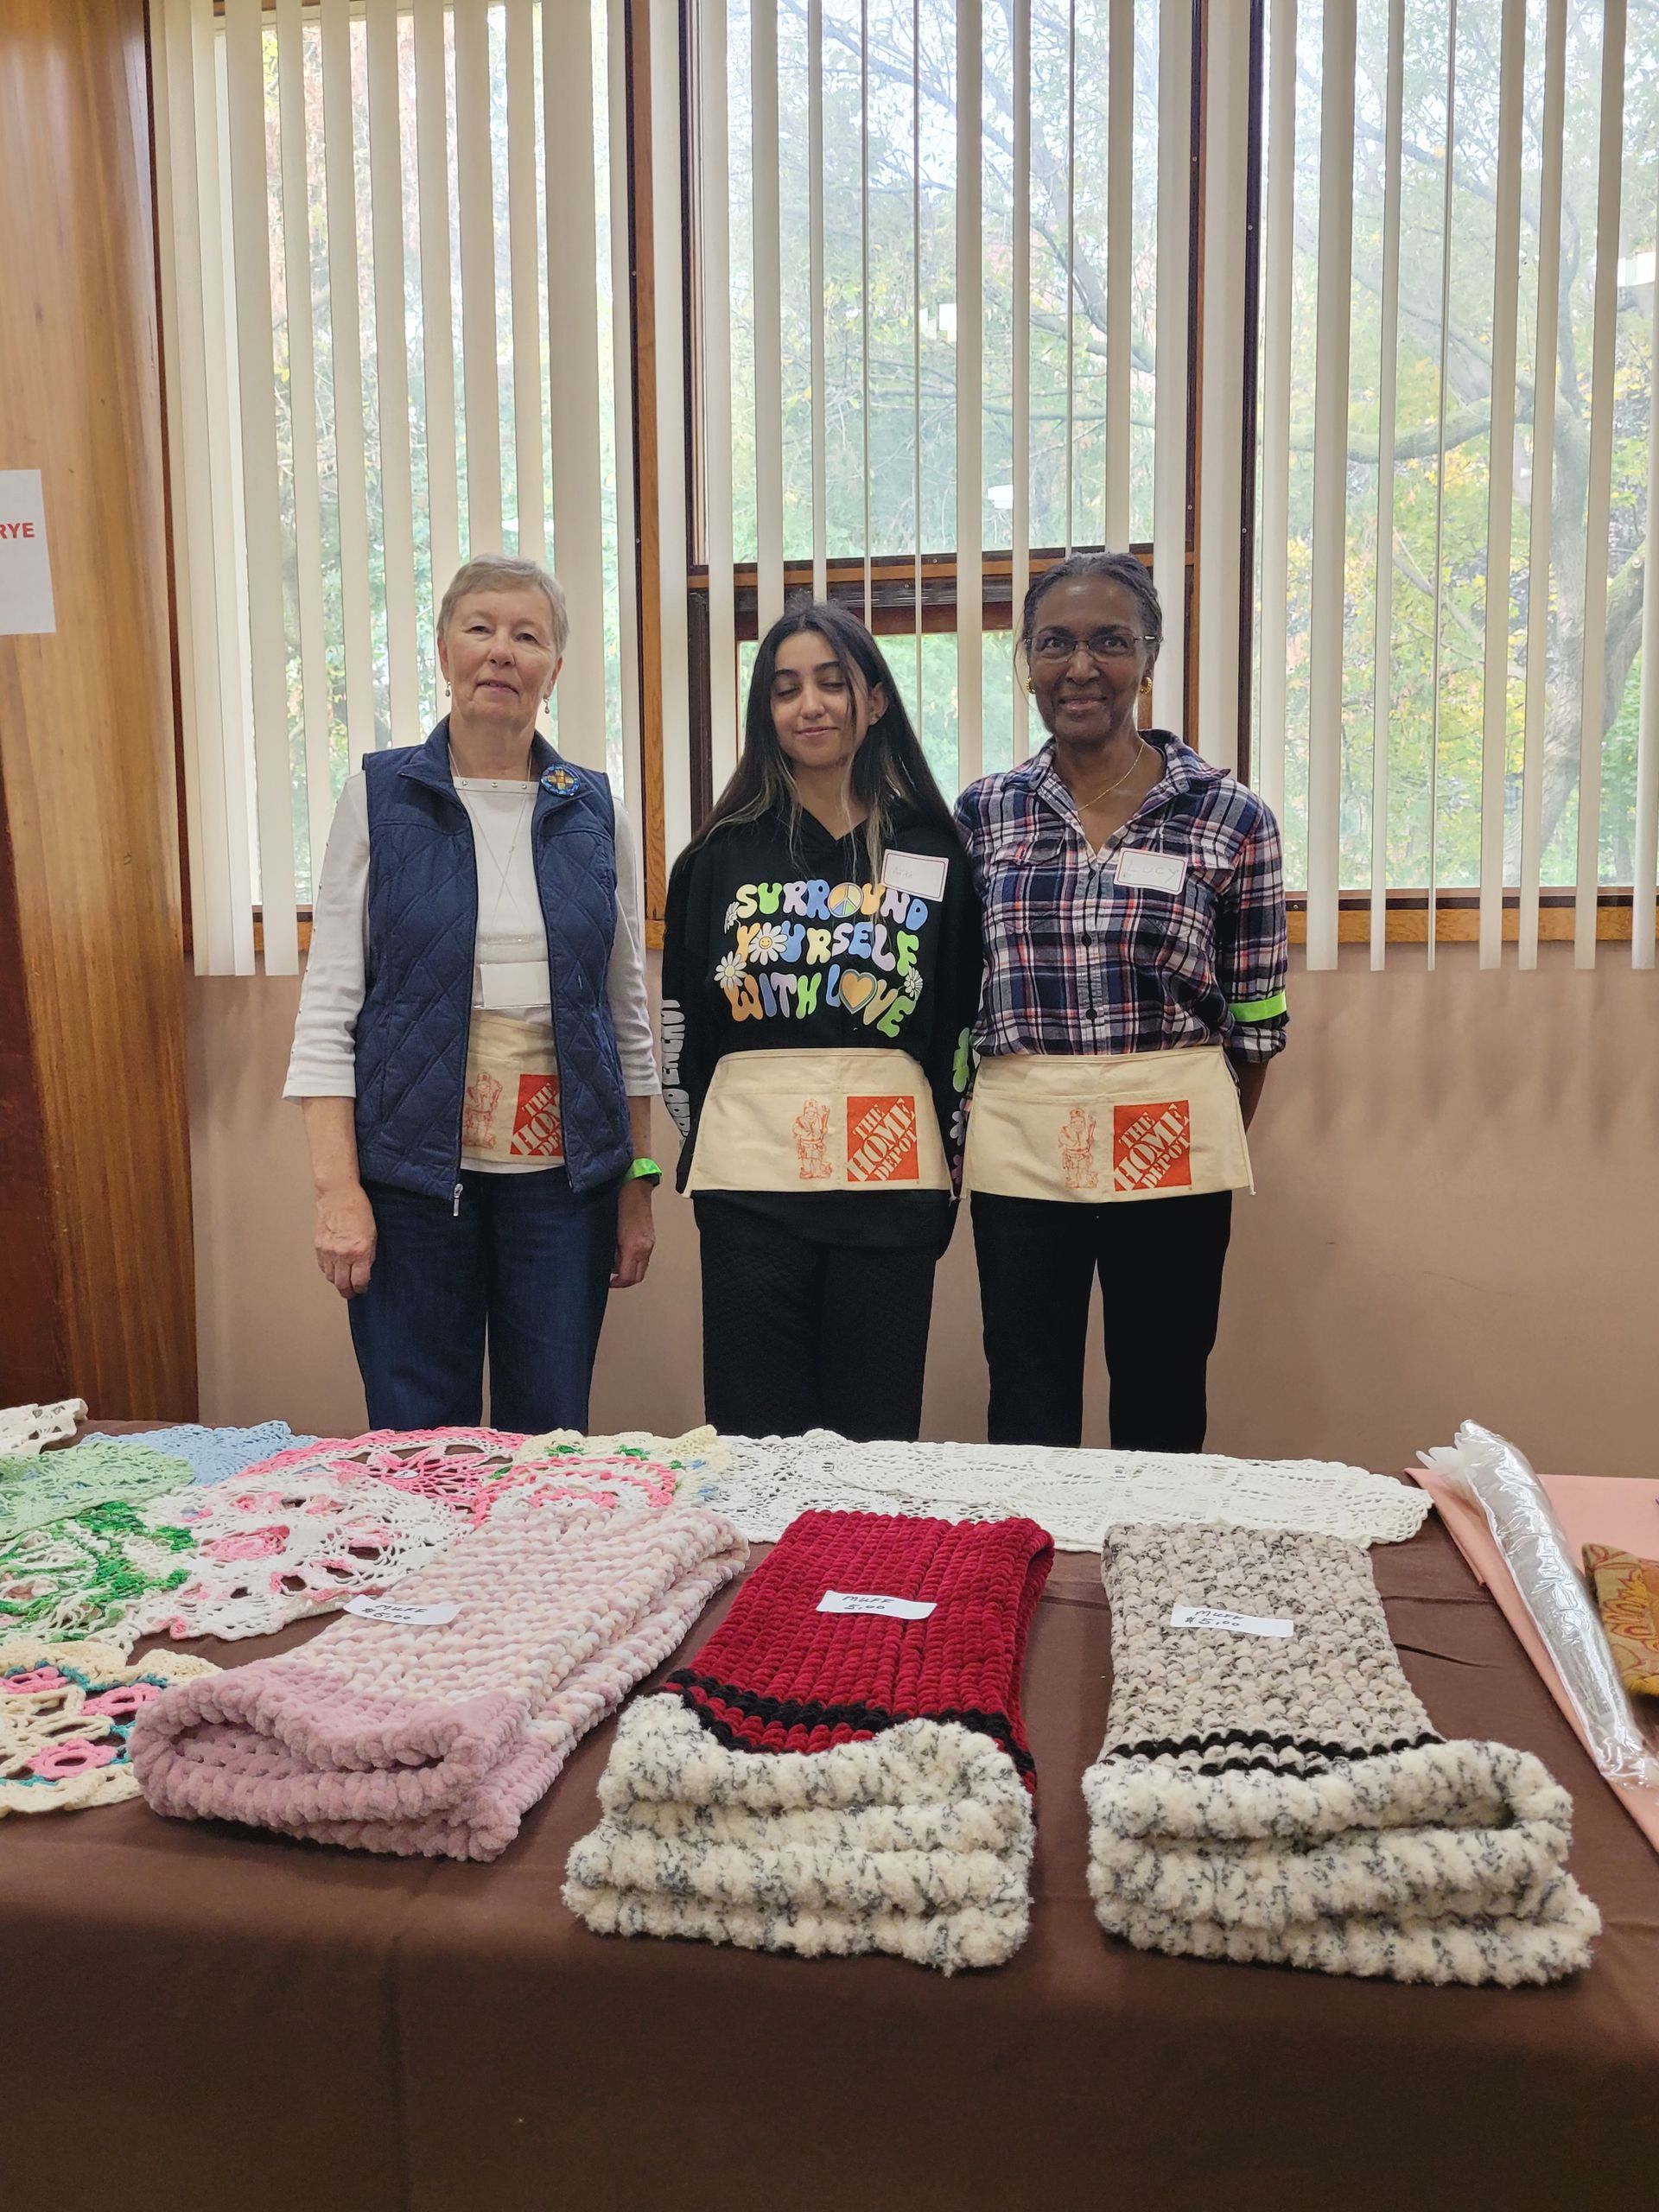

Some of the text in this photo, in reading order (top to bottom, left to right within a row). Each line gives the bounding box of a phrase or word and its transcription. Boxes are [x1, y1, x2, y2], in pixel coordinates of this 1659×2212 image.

[735, 880, 929, 931] SURROUND
[723, 963, 918, 1038] WITH LOVE
[521, 1082, 558, 1117] THE
[852, 1103, 886, 1141] THE
[847, 1096, 916, 1182] HOME
[874, 1126, 918, 1182] DEPOT
[1114, 1103, 1190, 1192] HOME
[1118, 1111, 1156, 1148] THE
[1141, 1132, 1191, 1189] DEPOT
